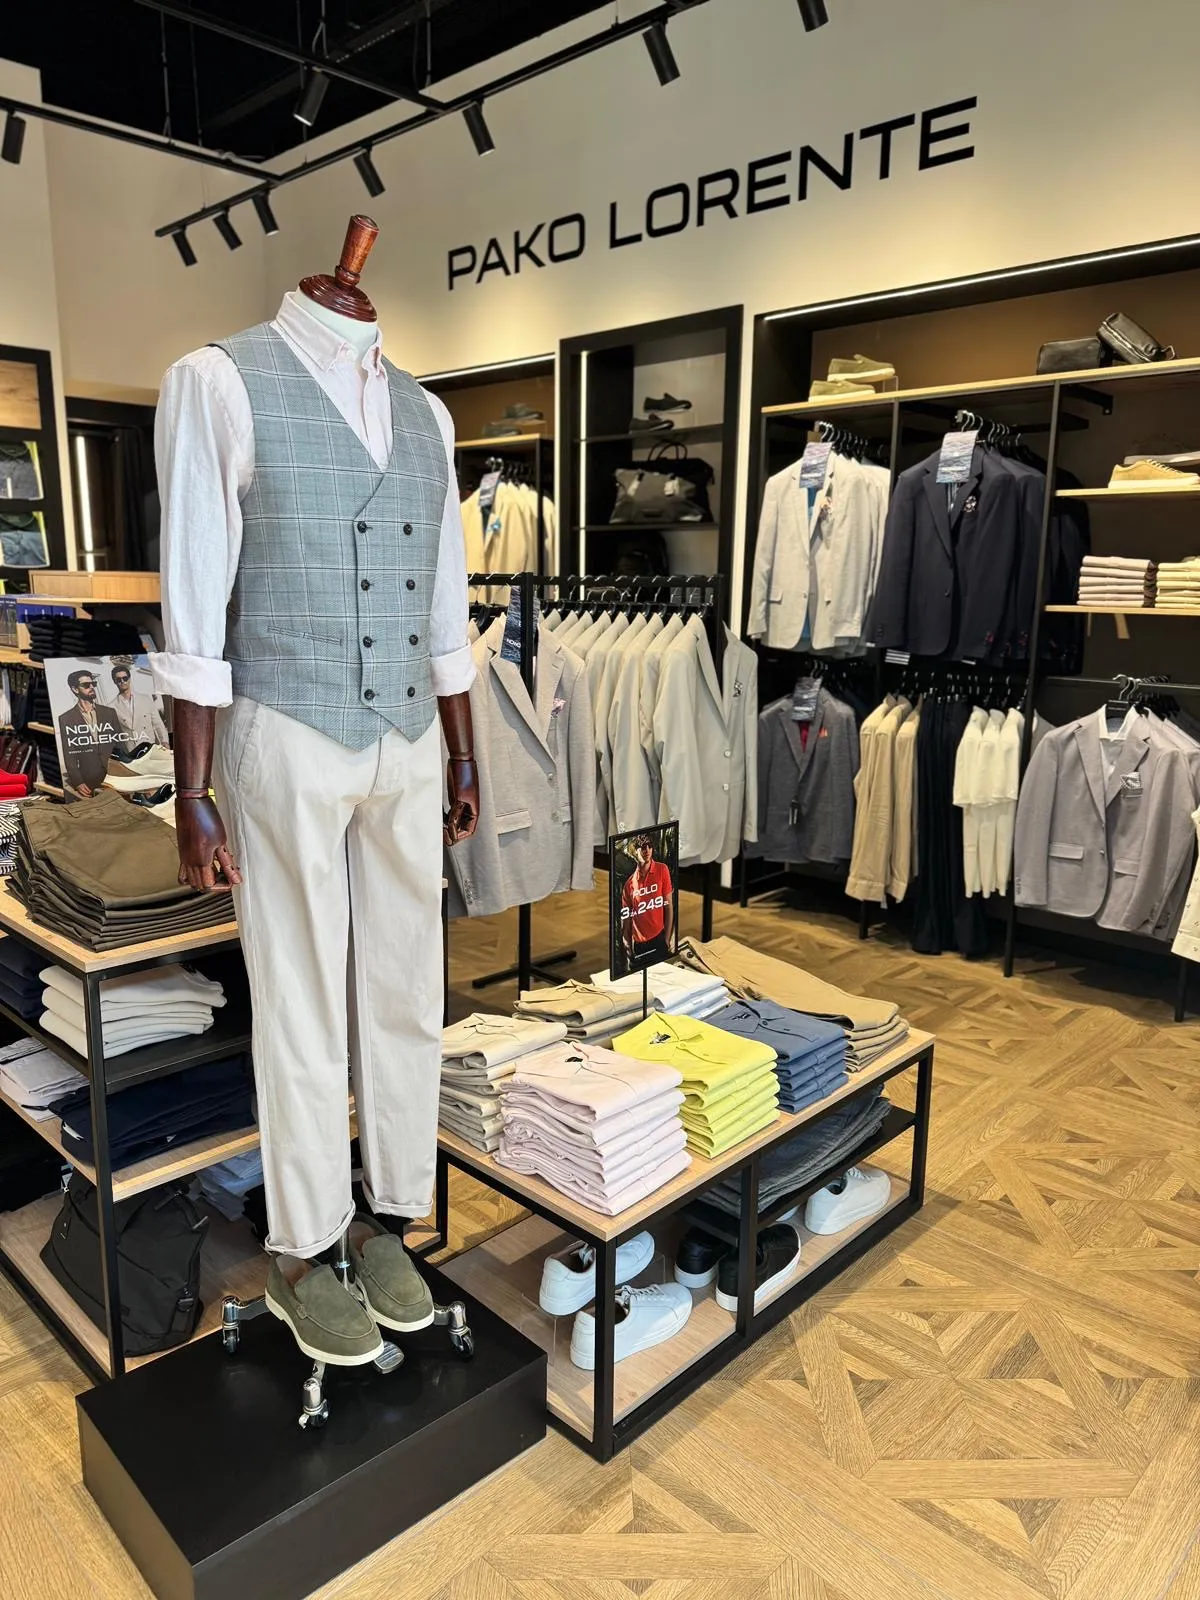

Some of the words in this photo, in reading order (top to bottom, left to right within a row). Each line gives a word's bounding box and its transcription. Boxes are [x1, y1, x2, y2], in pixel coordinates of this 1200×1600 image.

[447, 212, 586, 291] PAKO
[609, 96, 978, 249] LORENTE
[65, 722, 115, 735] NOWA
[67, 731, 150, 747] KOLEKCJA
[633, 884, 658, 897] POLO
[620, 907, 630, 920] 3
[638, 896, 663, 914] 249
